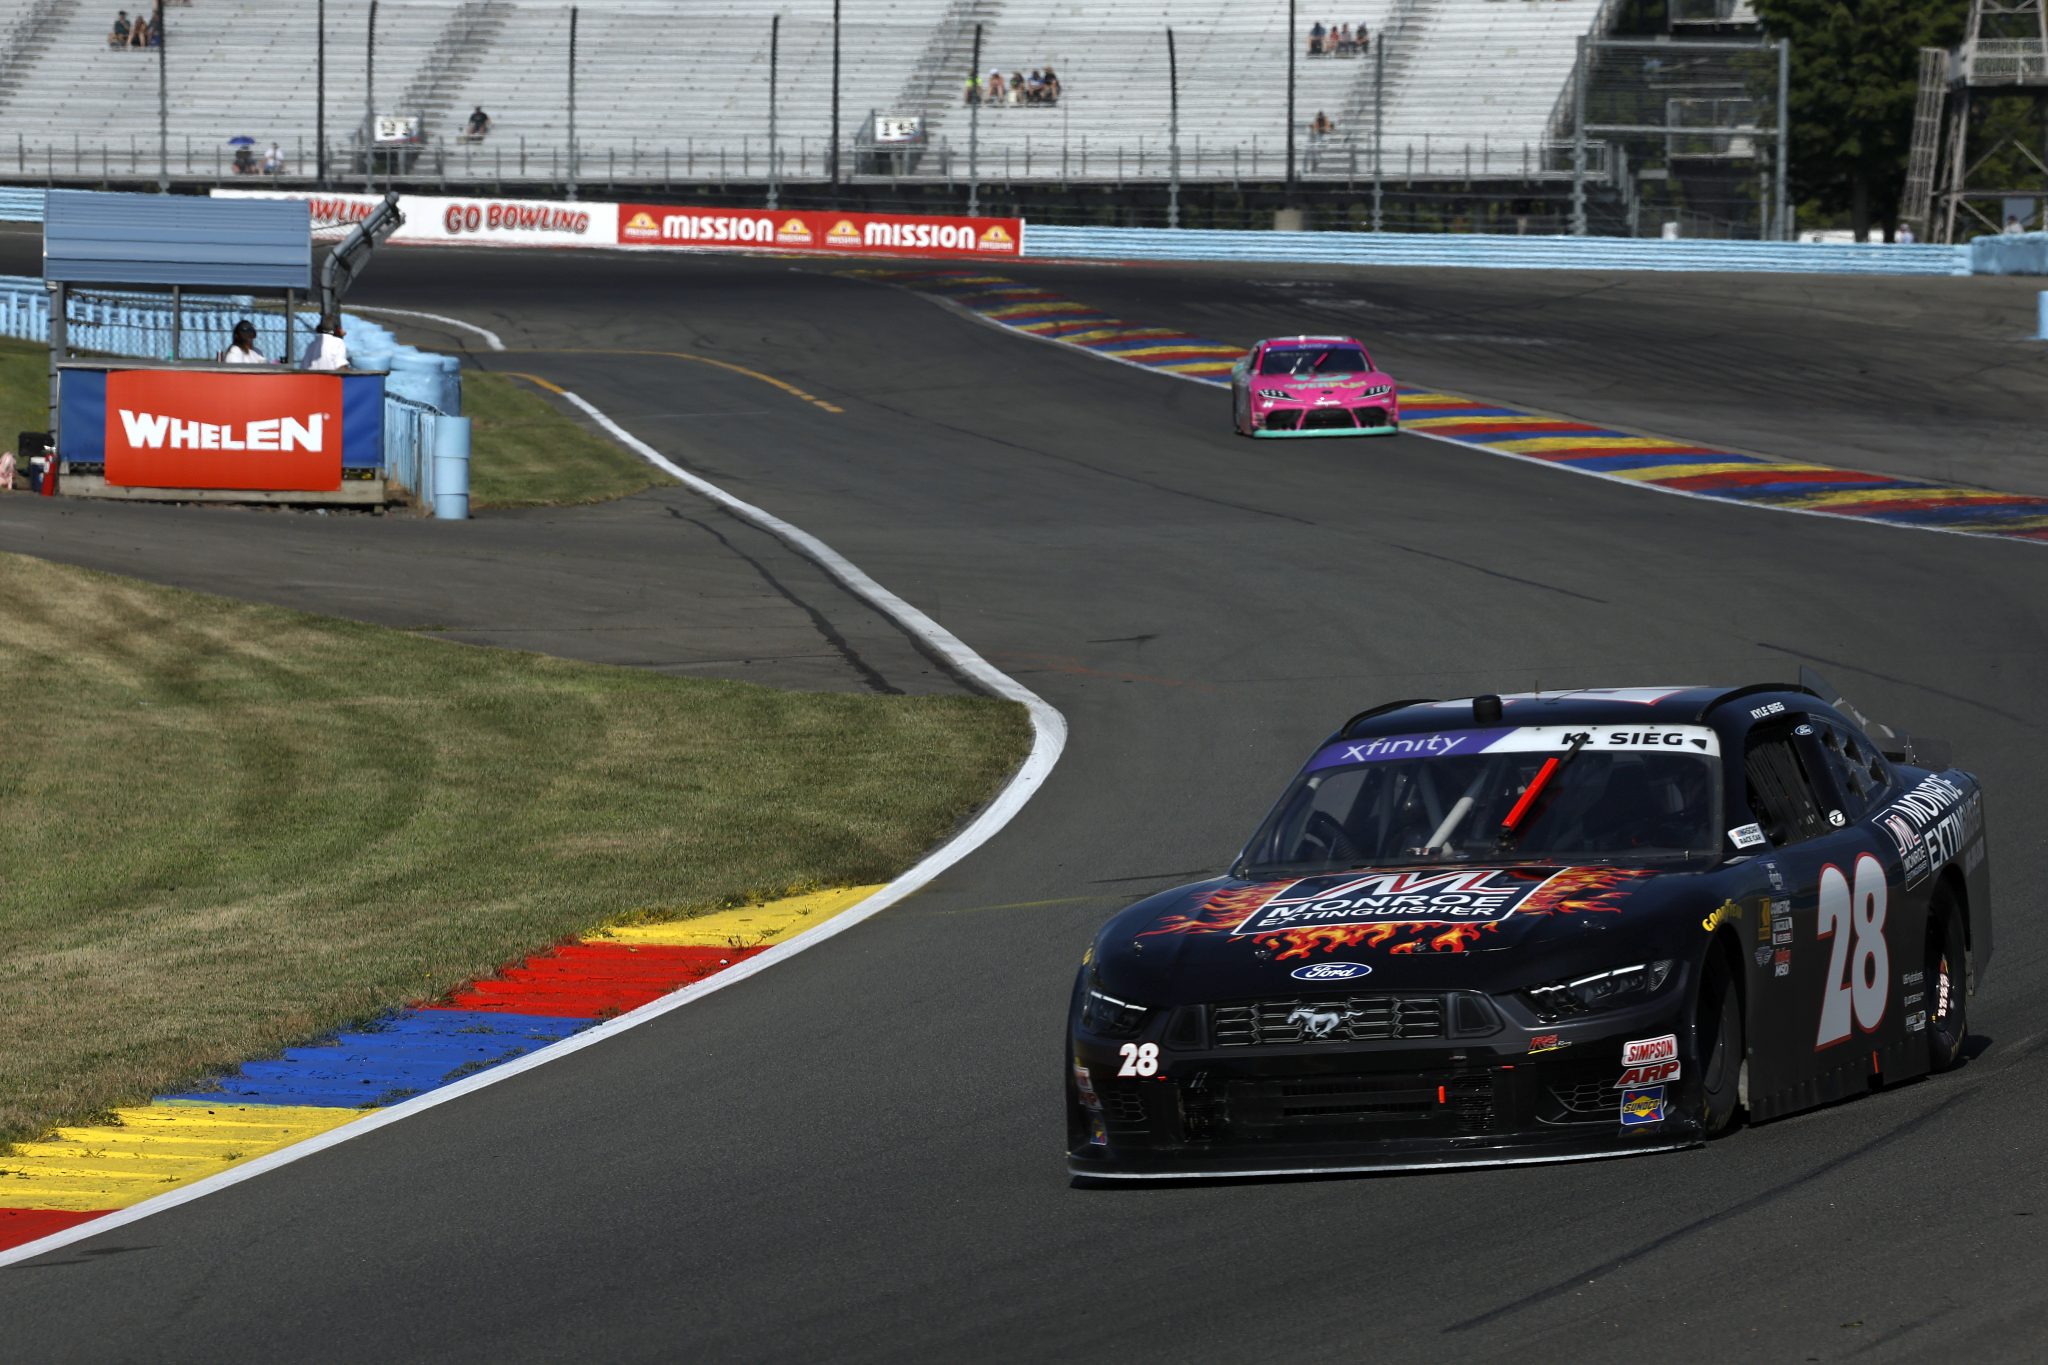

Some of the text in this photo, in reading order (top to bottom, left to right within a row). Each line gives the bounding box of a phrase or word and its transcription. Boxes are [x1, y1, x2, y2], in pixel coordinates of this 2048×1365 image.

[310, 198, 374, 224] WLIN
[444, 203, 590, 234] GO BOWLING
[119, 409, 323, 452] WHELEN
[1750, 702, 1785, 719] KYLE SIEG
[1341, 731, 1467, 762] xfinity
[1608, 732, 1683, 746] SIEG
[1738, 835, 1753, 844] RACE
[1904, 845, 1926, 871] MONROE
[1257, 905, 1496, 927] EXTINGUISHER
[1266, 894, 1510, 918] MONROE
[1814, 852, 1889, 1052] 28
[1305, 963, 1358, 979] Ford
[1117, 1042, 1159, 1077] 28
[1627, 1039, 1674, 1062] SIMPSON
[1618, 1062, 1680, 1085] ARP
[1623, 1100, 1661, 1113] SUNOCO
